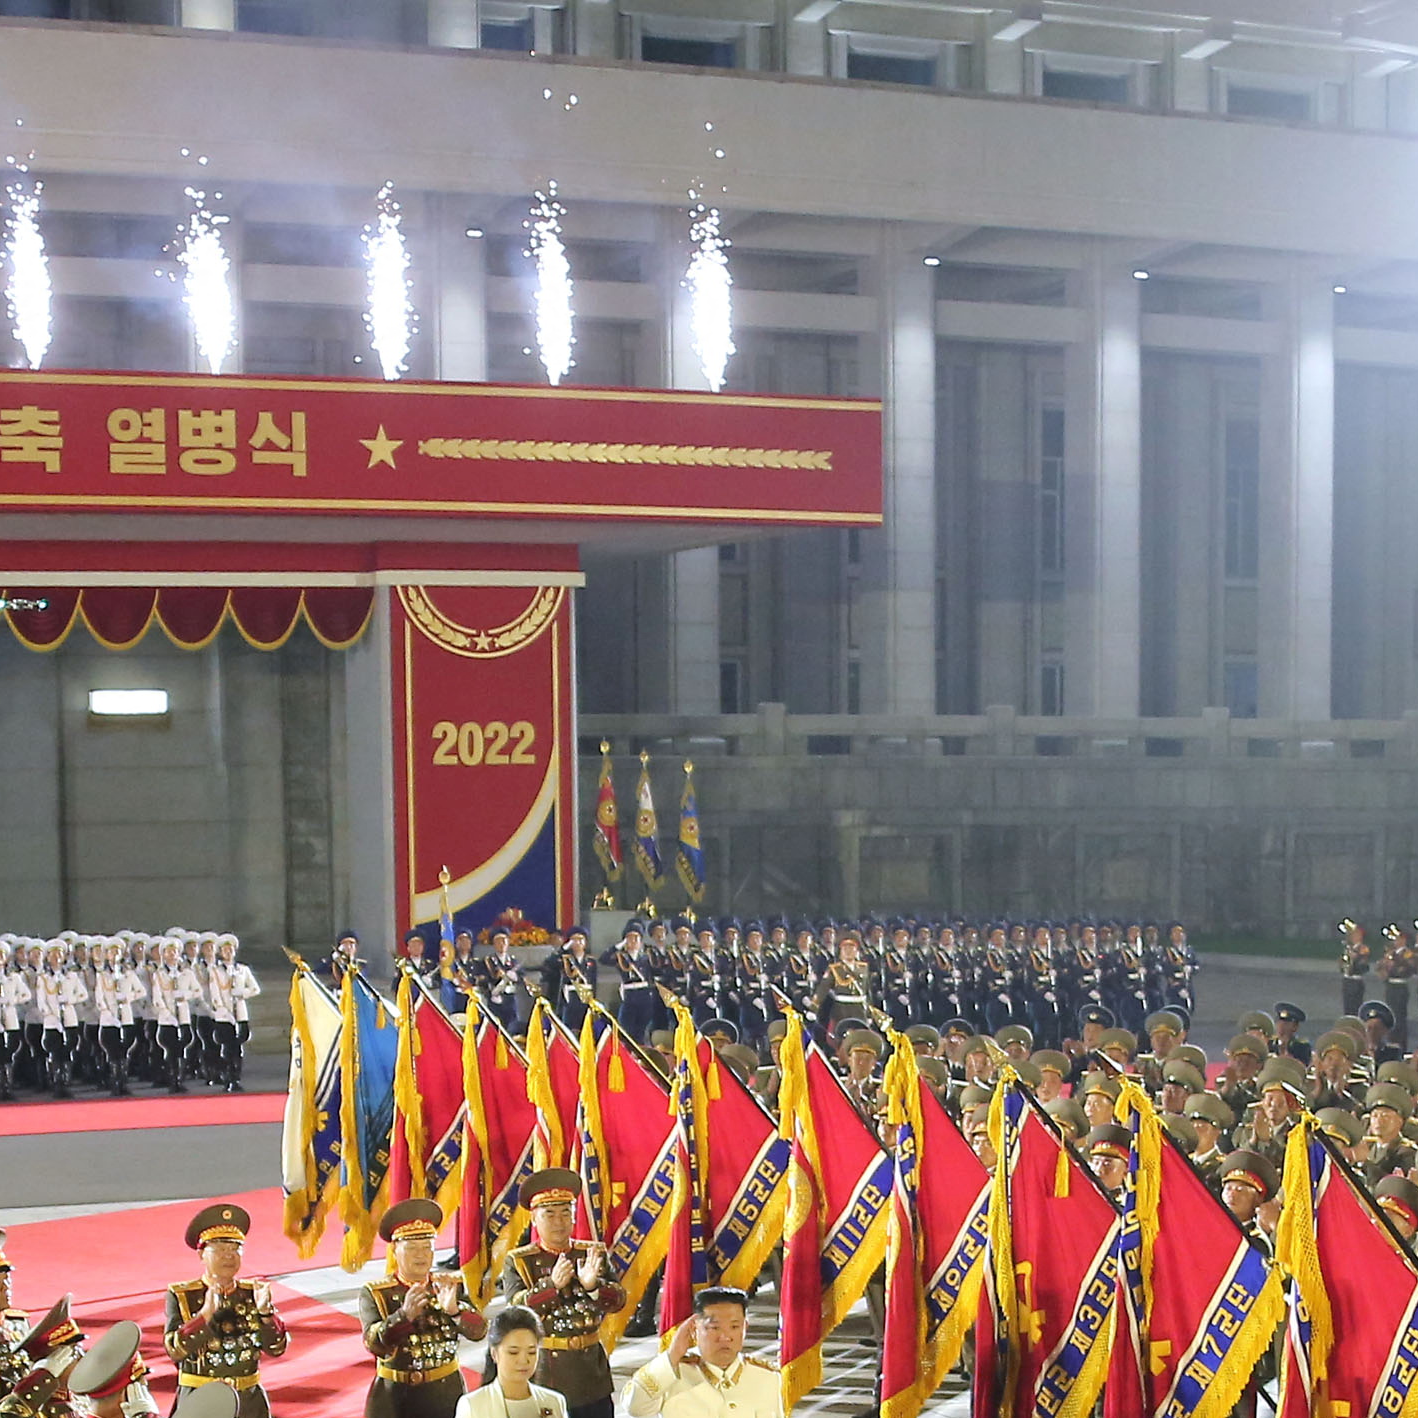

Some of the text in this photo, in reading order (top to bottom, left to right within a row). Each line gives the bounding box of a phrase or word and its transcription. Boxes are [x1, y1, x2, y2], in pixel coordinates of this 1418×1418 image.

[106, 406, 308, 478] 열병식
[431, 720, 536, 766] 2022
[730, 1159, 782, 1241] 제5군단
[825, 1183, 885, 1271] 제11군단
[1184, 1281, 1256, 1390] 제7군단
